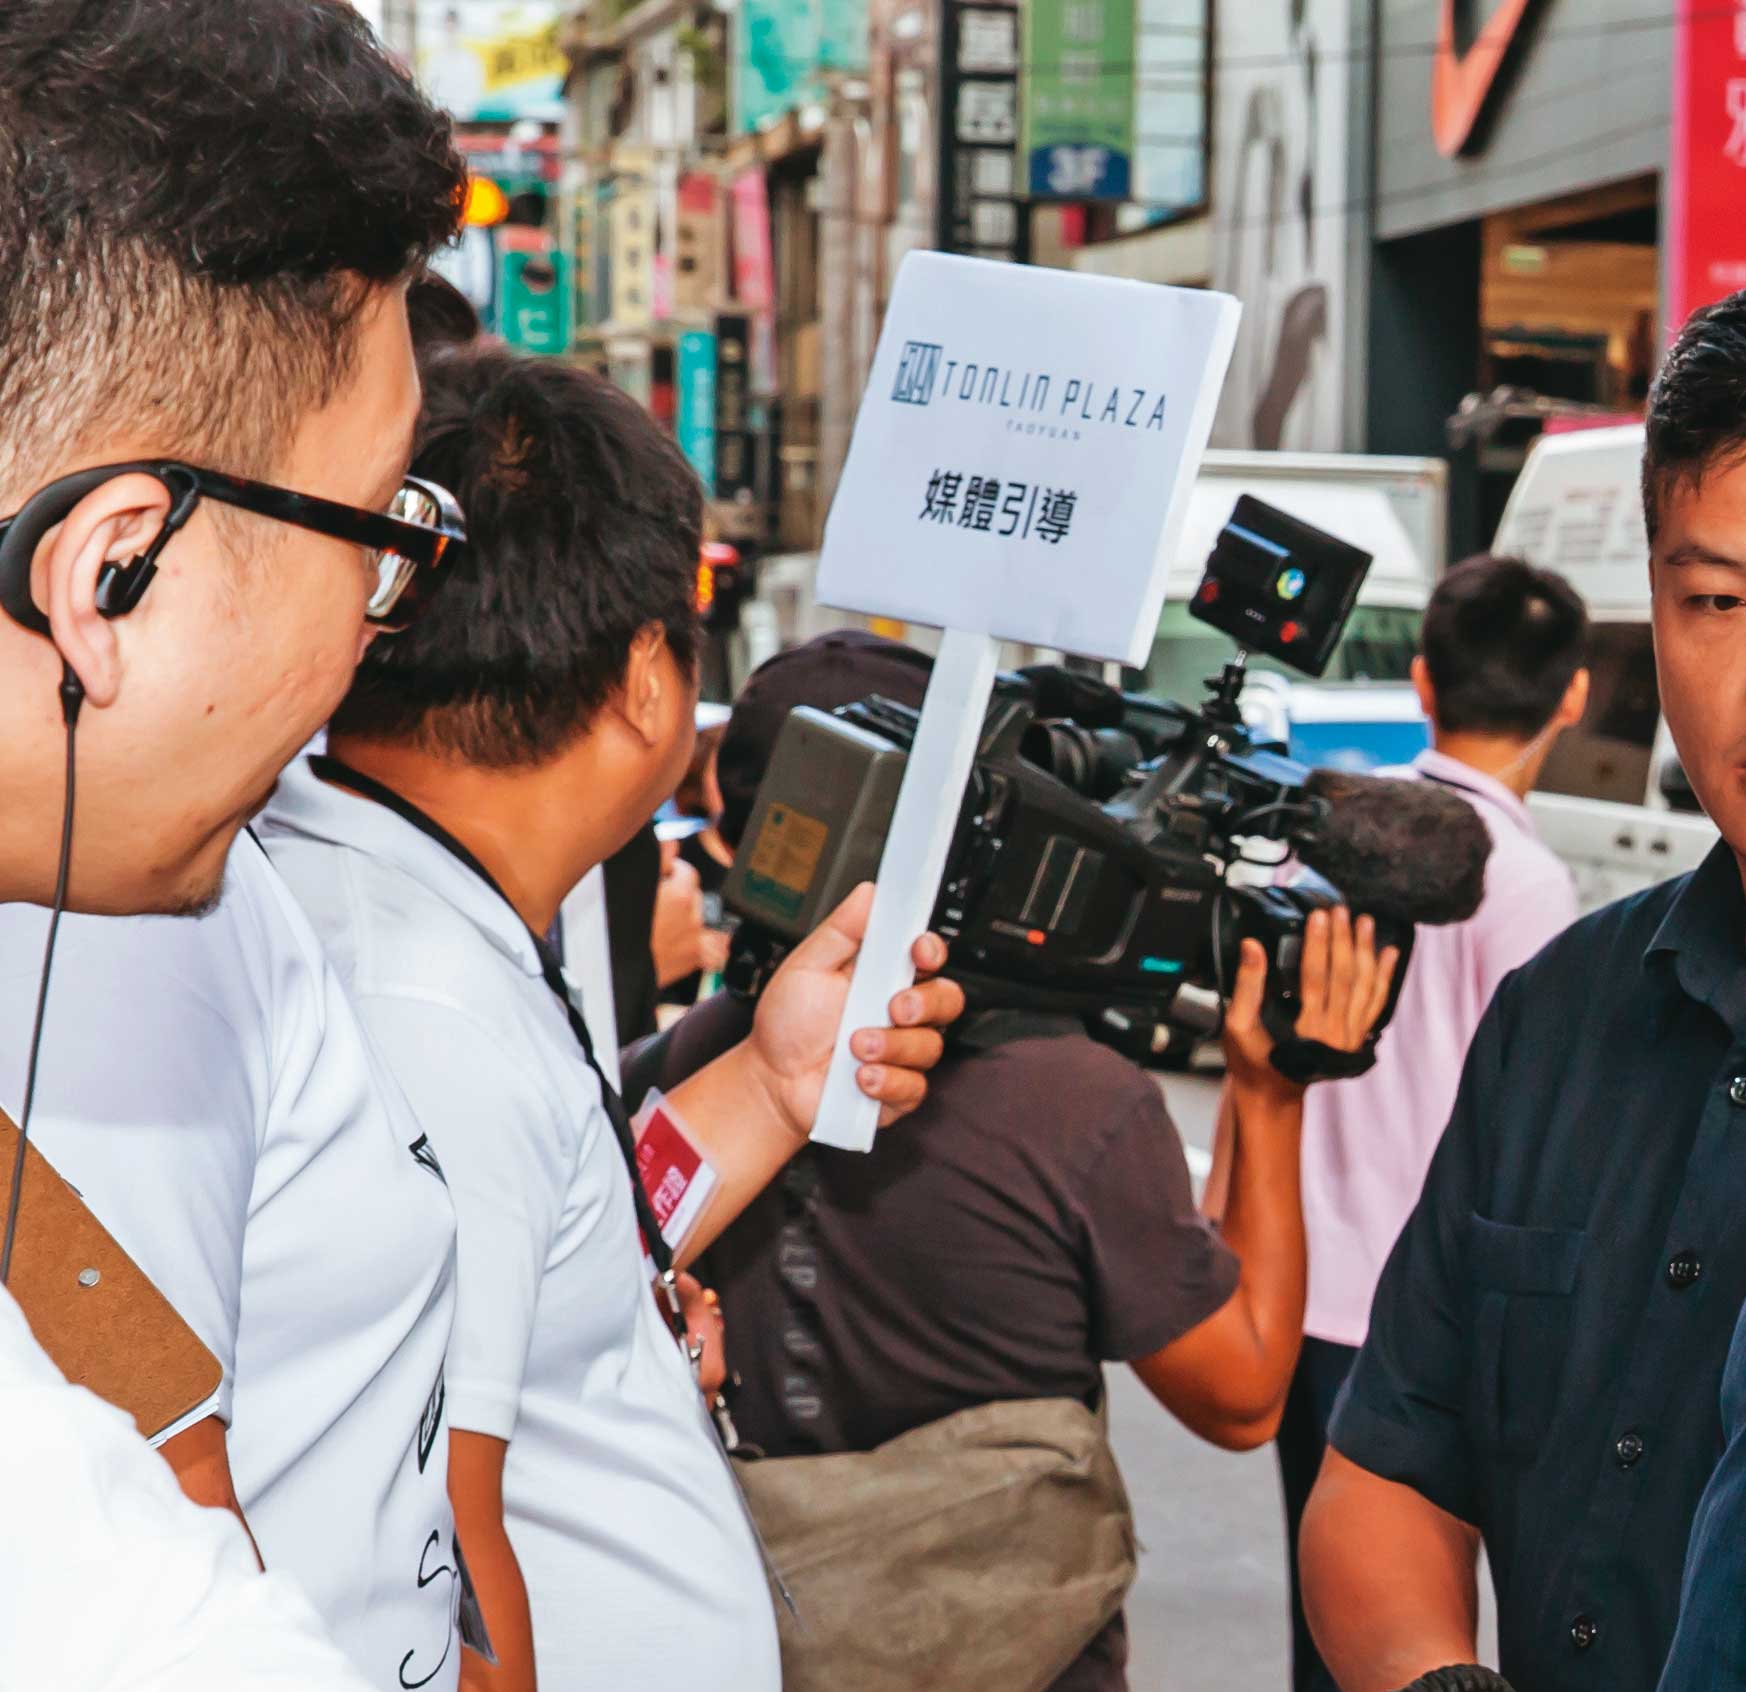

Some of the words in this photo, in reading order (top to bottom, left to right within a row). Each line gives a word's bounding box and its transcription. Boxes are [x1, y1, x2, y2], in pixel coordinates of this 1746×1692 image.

[940, 360, 1050, 412] TONLIN
[1060, 379, 1167, 431] PLAZA
[919, 468, 1079, 545] 媒體引導
